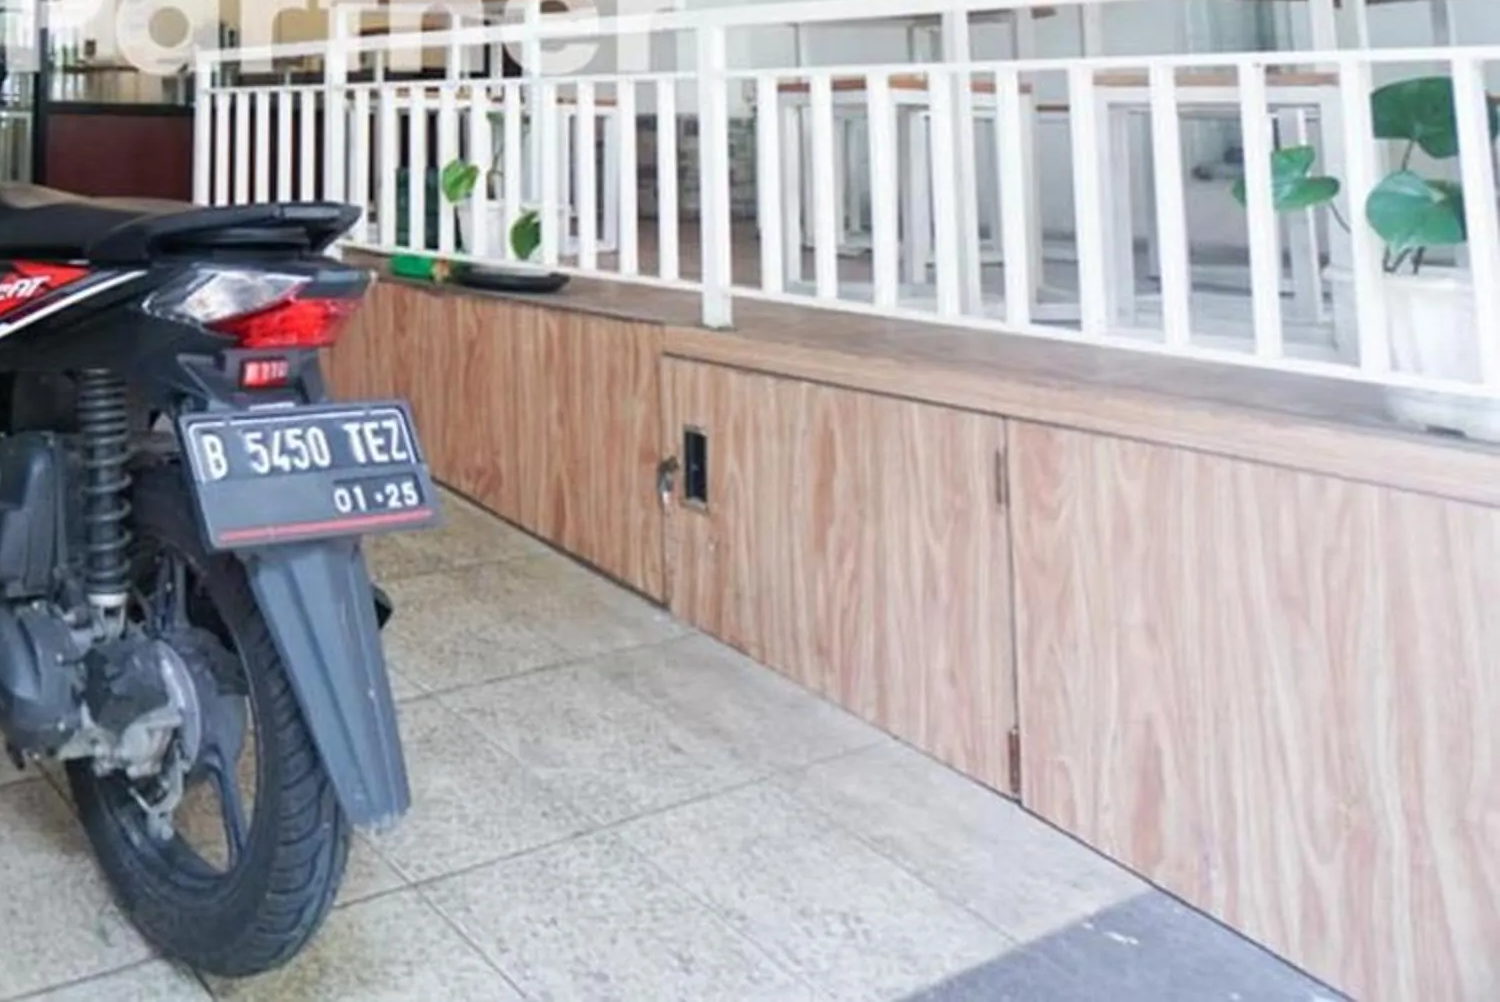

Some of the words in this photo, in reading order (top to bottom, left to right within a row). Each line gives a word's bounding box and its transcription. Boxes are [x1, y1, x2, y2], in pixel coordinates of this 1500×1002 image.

[202, 432, 229, 481] B
[243, 425, 331, 475] 5450
[341, 418, 408, 465] TEZ
